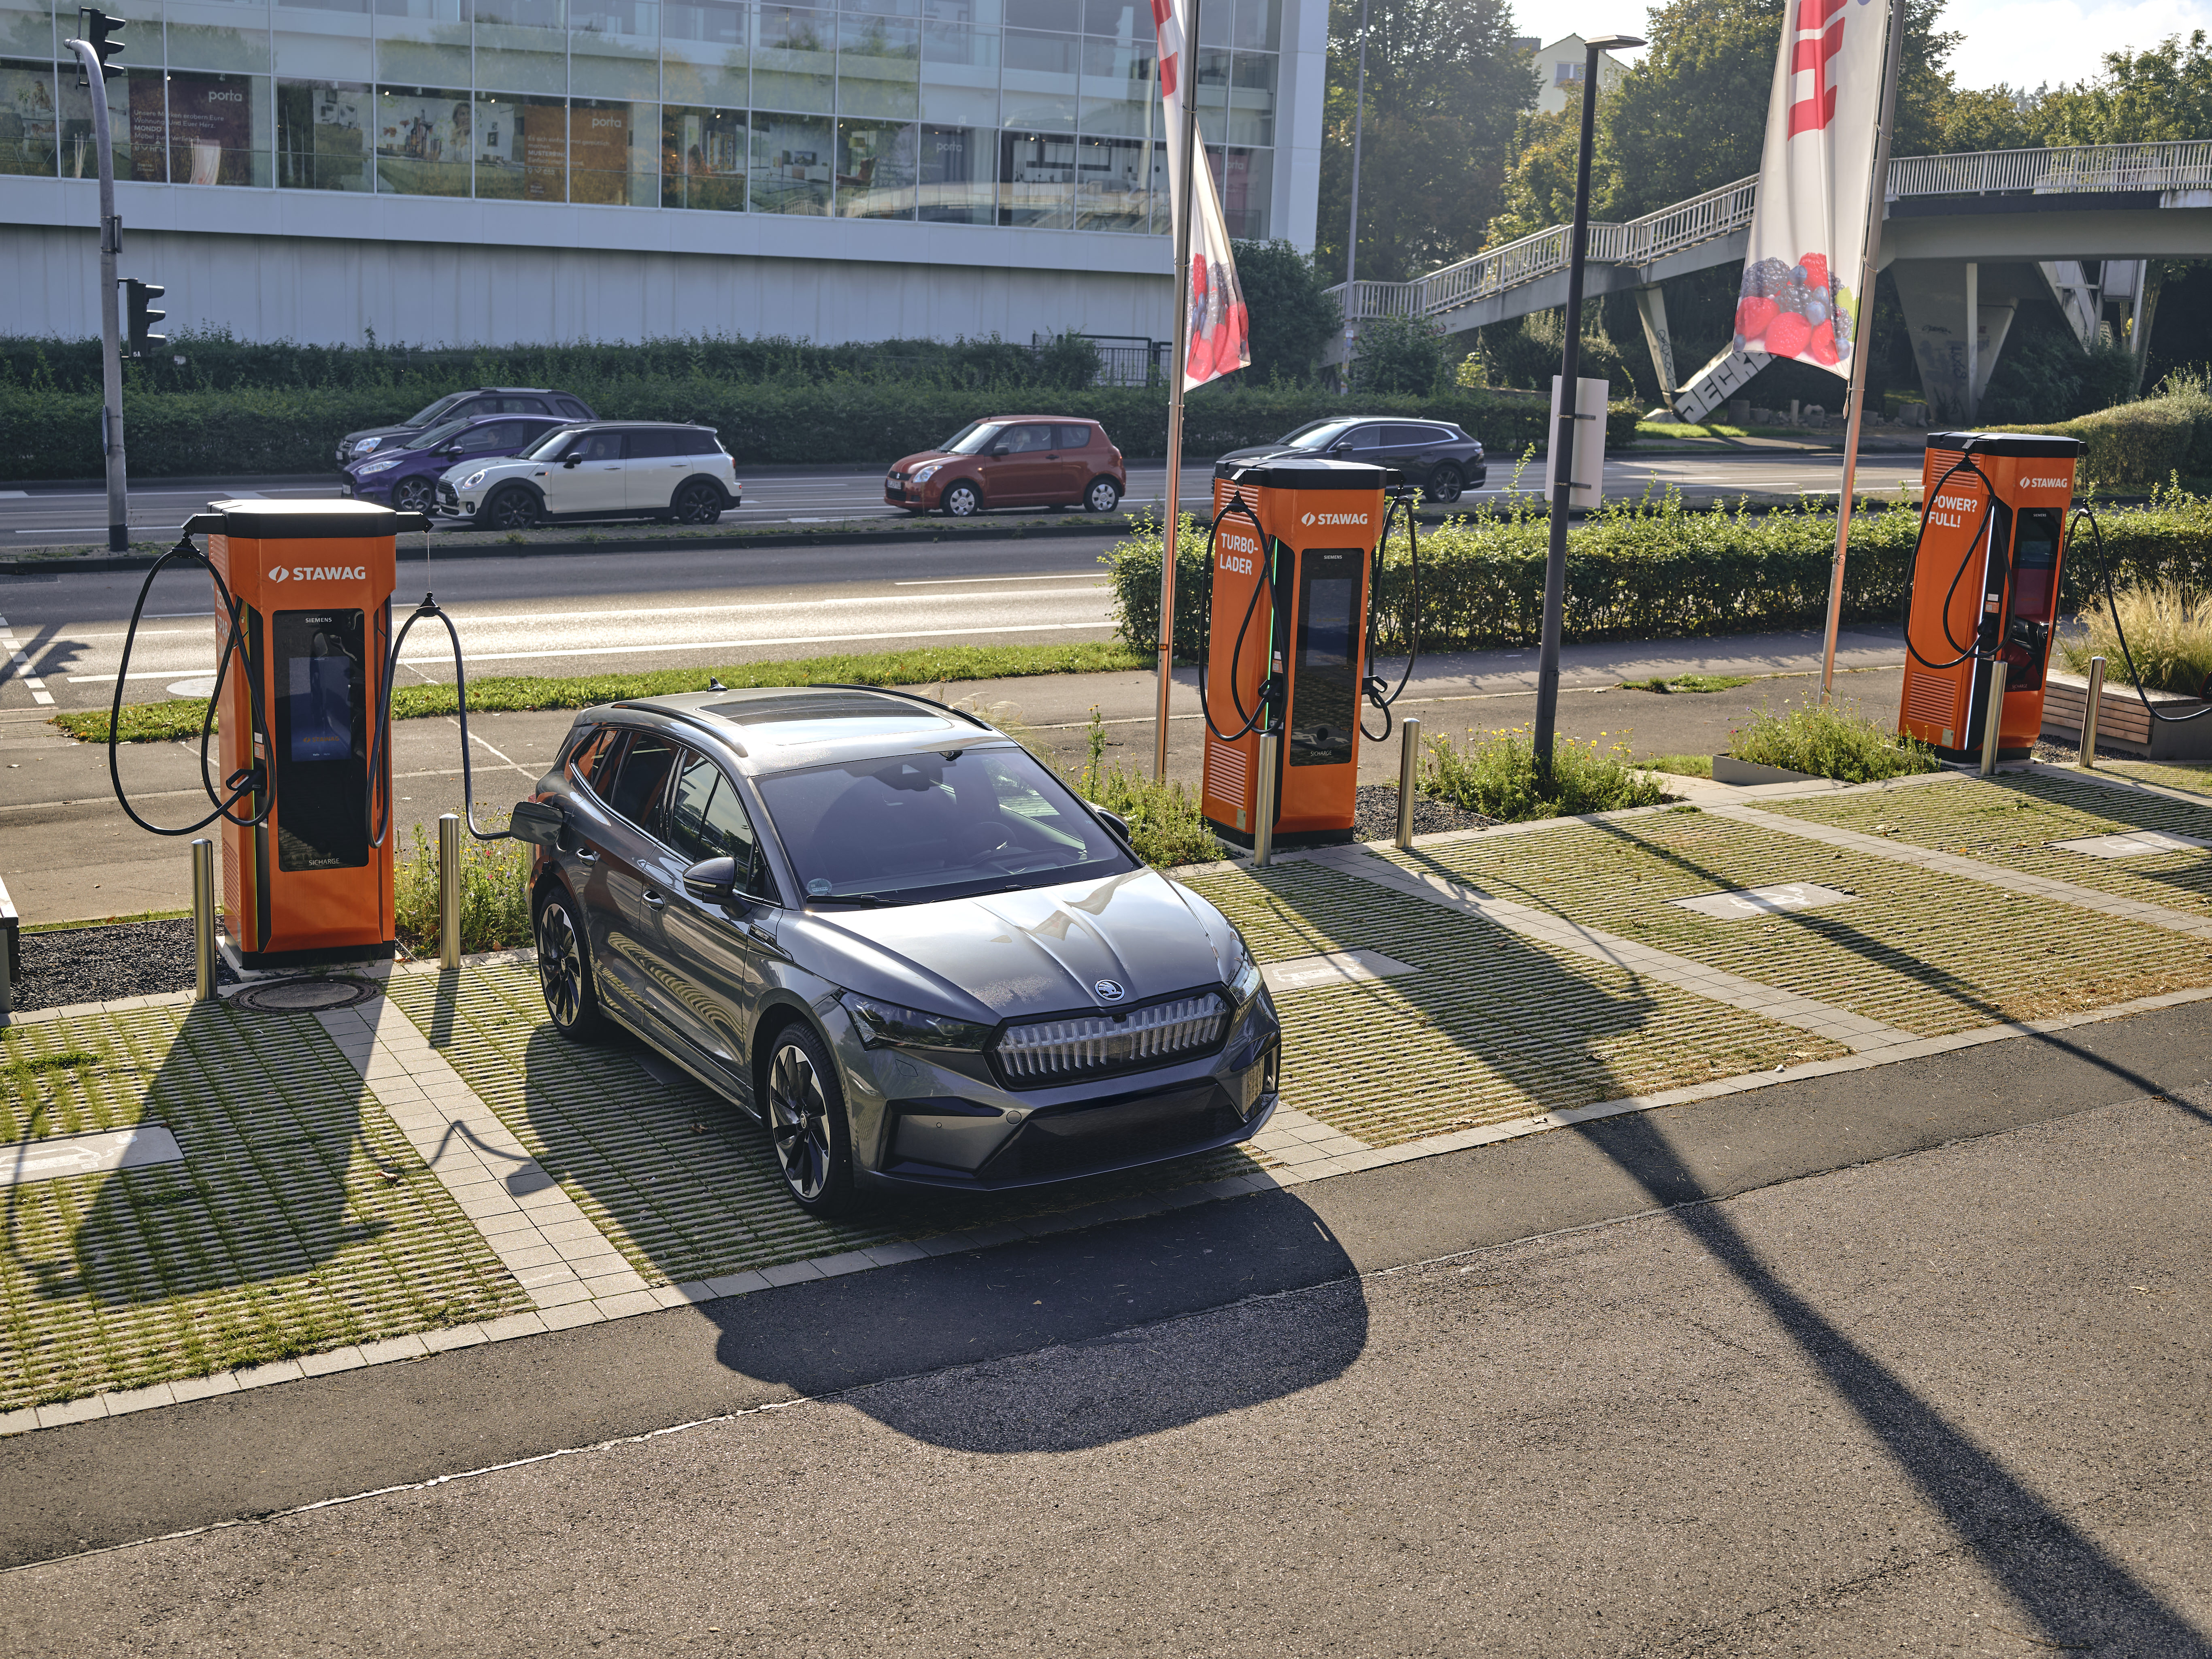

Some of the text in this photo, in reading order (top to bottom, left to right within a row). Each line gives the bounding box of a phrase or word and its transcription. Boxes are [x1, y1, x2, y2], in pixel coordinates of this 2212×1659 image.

[209, 89, 242, 102] porta
[592, 117, 622, 128] porta
[937, 141, 962, 153] porta
[1227, 160, 1244, 170] orta
[2031, 478, 2067, 488] STAWAG
[1318, 513, 1368, 525] STAWAG
[1929, 511, 1961, 528] FULL!
[1221, 532, 1258, 554] TURBO-
[1220, 554, 1252, 575] LADER
[293, 566, 366, 581] STAWAG
